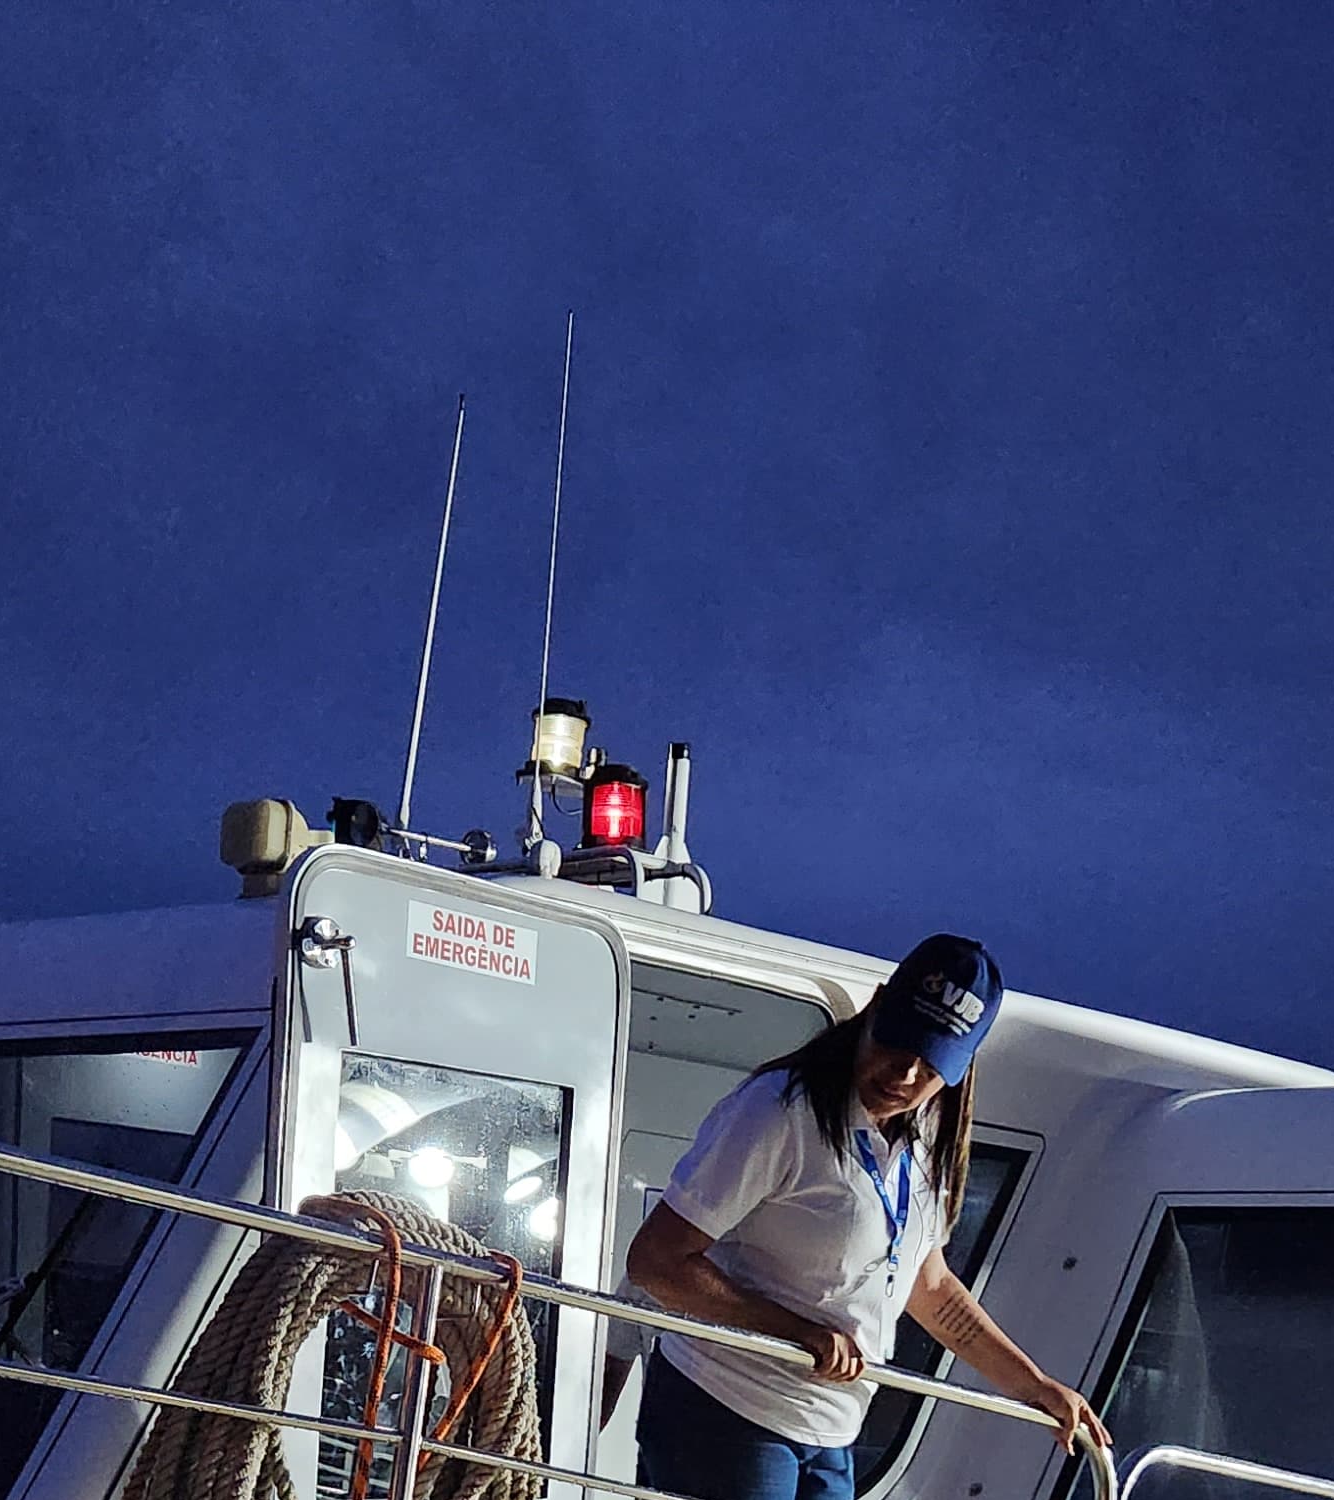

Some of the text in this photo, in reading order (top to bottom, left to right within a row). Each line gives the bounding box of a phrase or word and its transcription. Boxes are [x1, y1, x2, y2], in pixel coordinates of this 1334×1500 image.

[432, 909, 516, 949] SAIDA DE
[412, 932, 531, 980] EMERGÊNCIA
